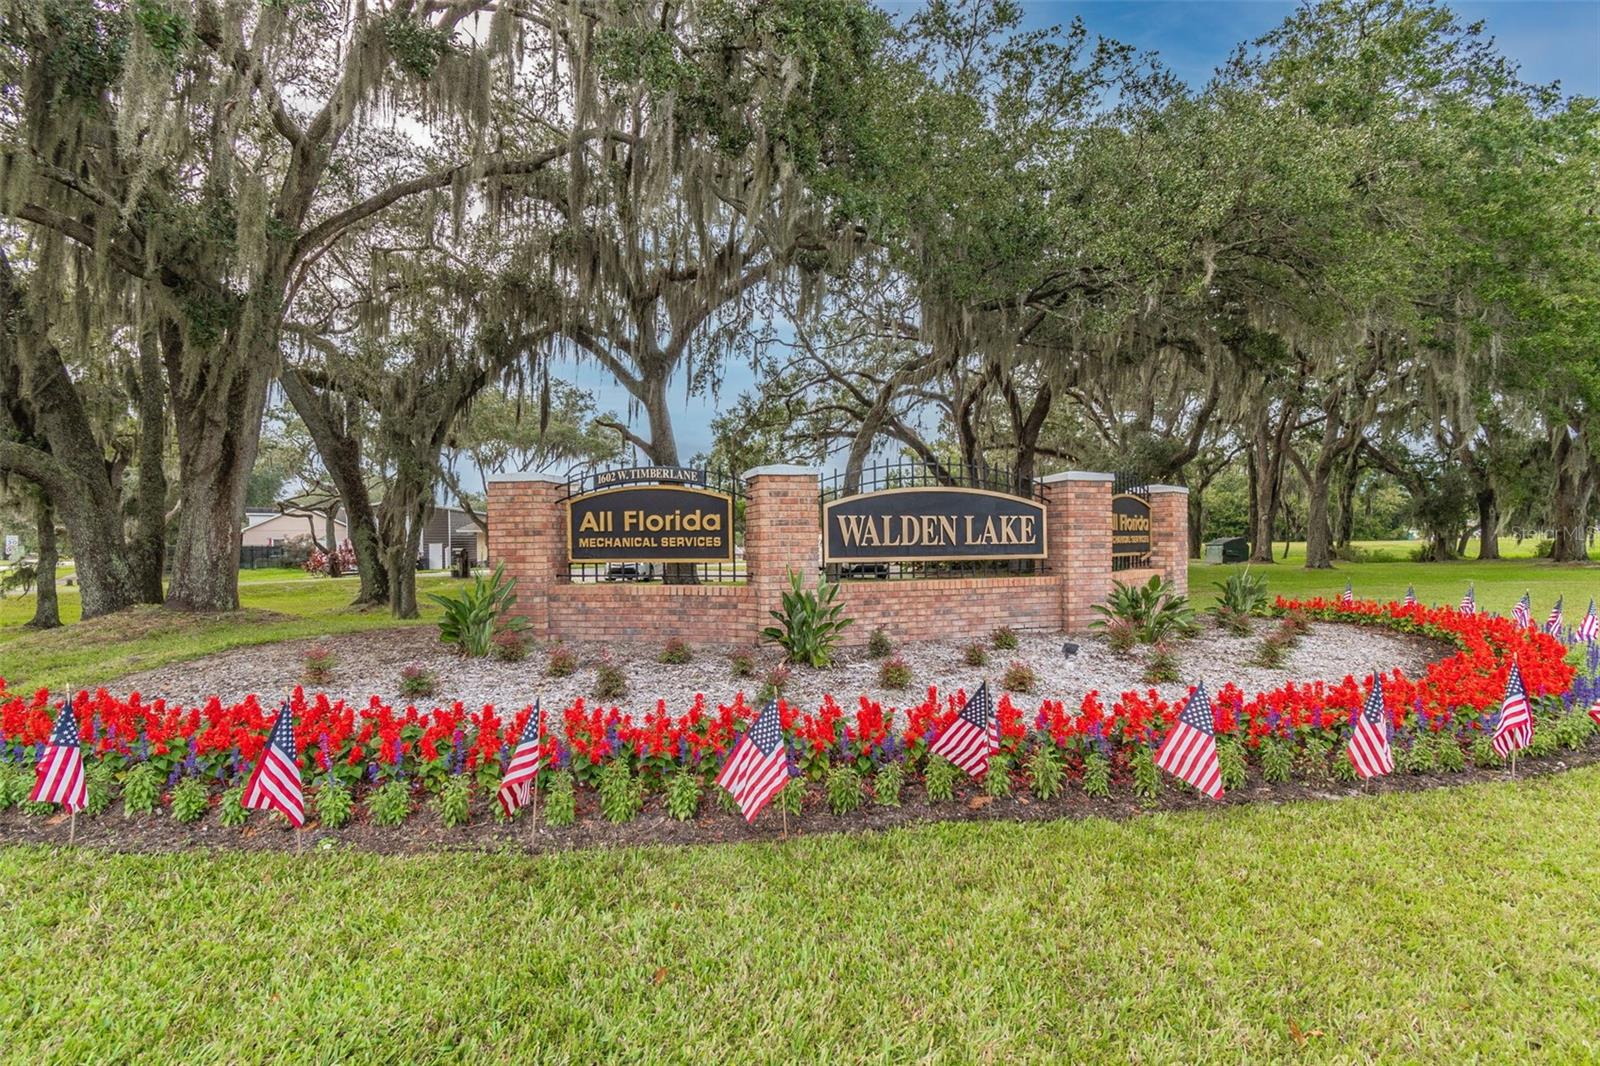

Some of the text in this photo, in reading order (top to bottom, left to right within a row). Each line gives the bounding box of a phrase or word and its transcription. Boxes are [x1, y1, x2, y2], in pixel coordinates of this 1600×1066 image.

[597, 468, 698, 484] 1602 W. TIMBERLANE
[579, 510, 721, 532] All Florida
[837, 515, 1037, 547] WALDEN LAKE
[578, 536, 722, 548] MECHANICAL SERVICES
